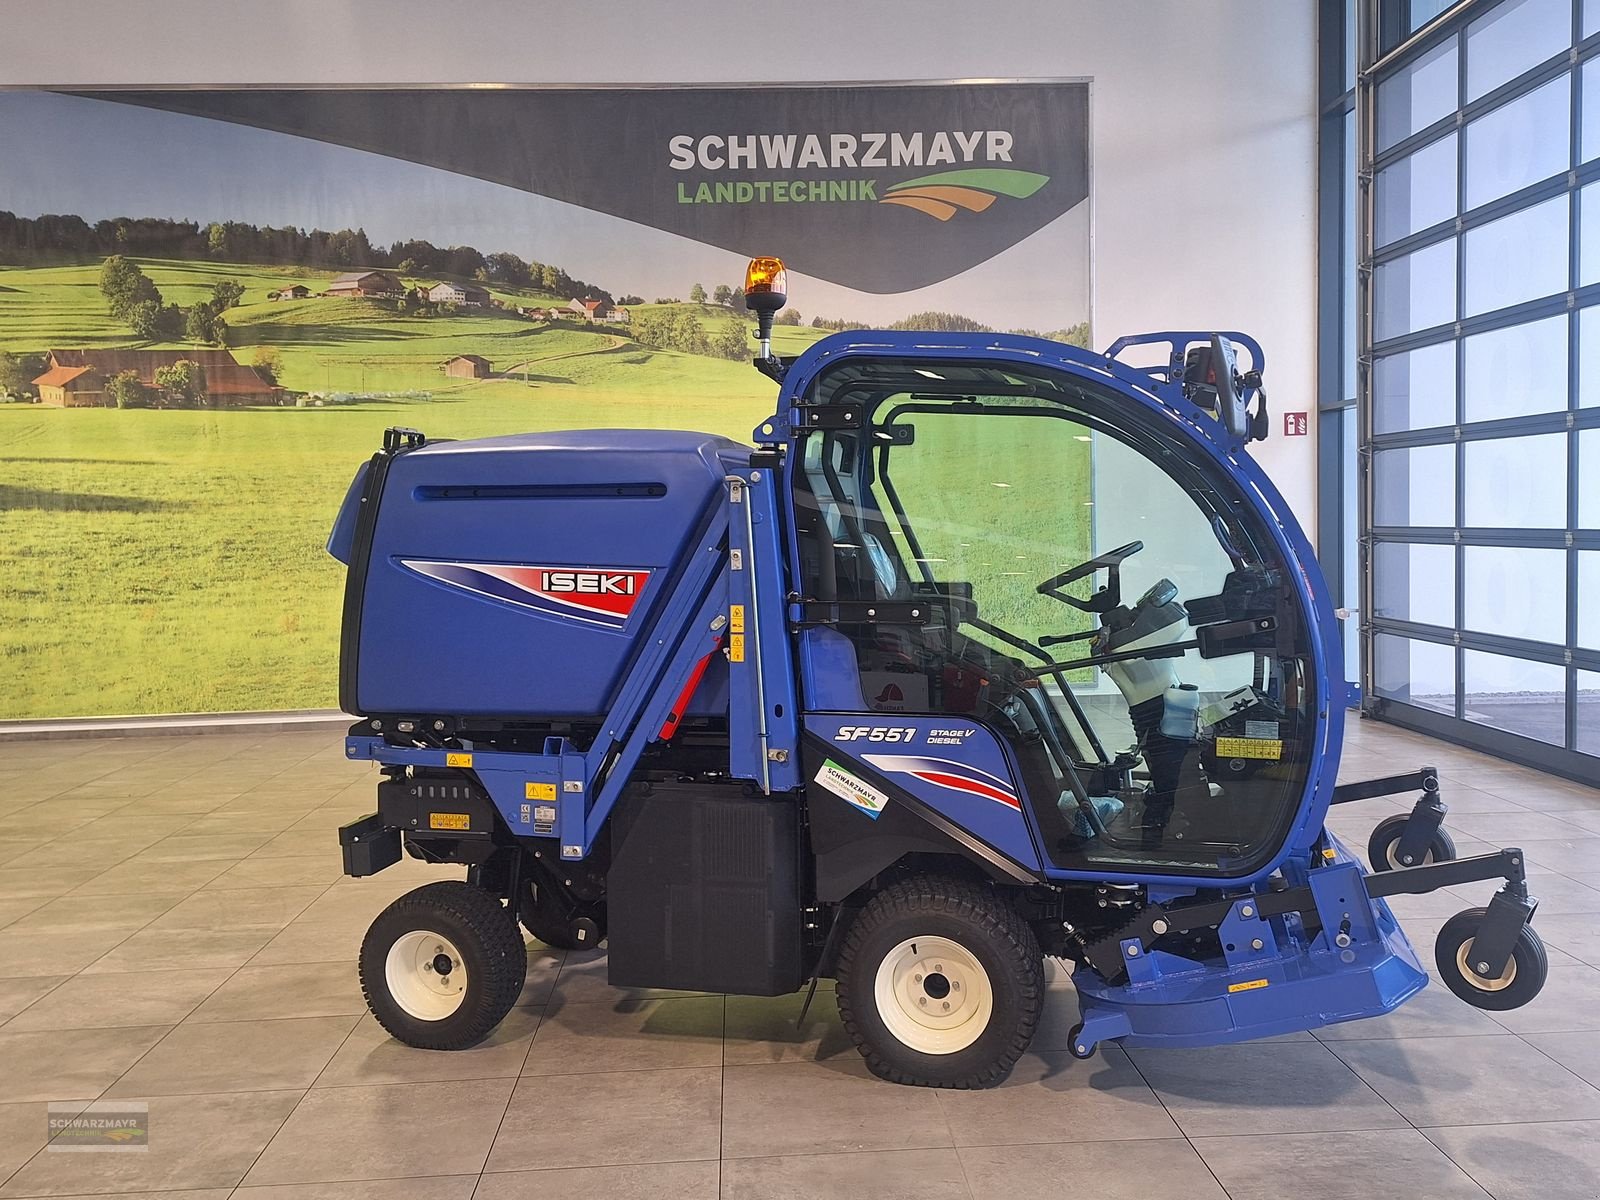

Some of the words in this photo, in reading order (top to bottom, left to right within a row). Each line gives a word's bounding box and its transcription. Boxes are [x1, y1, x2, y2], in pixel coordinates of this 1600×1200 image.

[668, 130, 1013, 170] SCHWARZMAYR
[677, 179, 878, 205] LANDTECHNIK
[541, 571, 635, 595] ISEKI
[834, 726, 917, 743] SF551
[926, 737, 963, 745] DIESEL
[826, 766, 877, 802] SCHWARZMAYR
